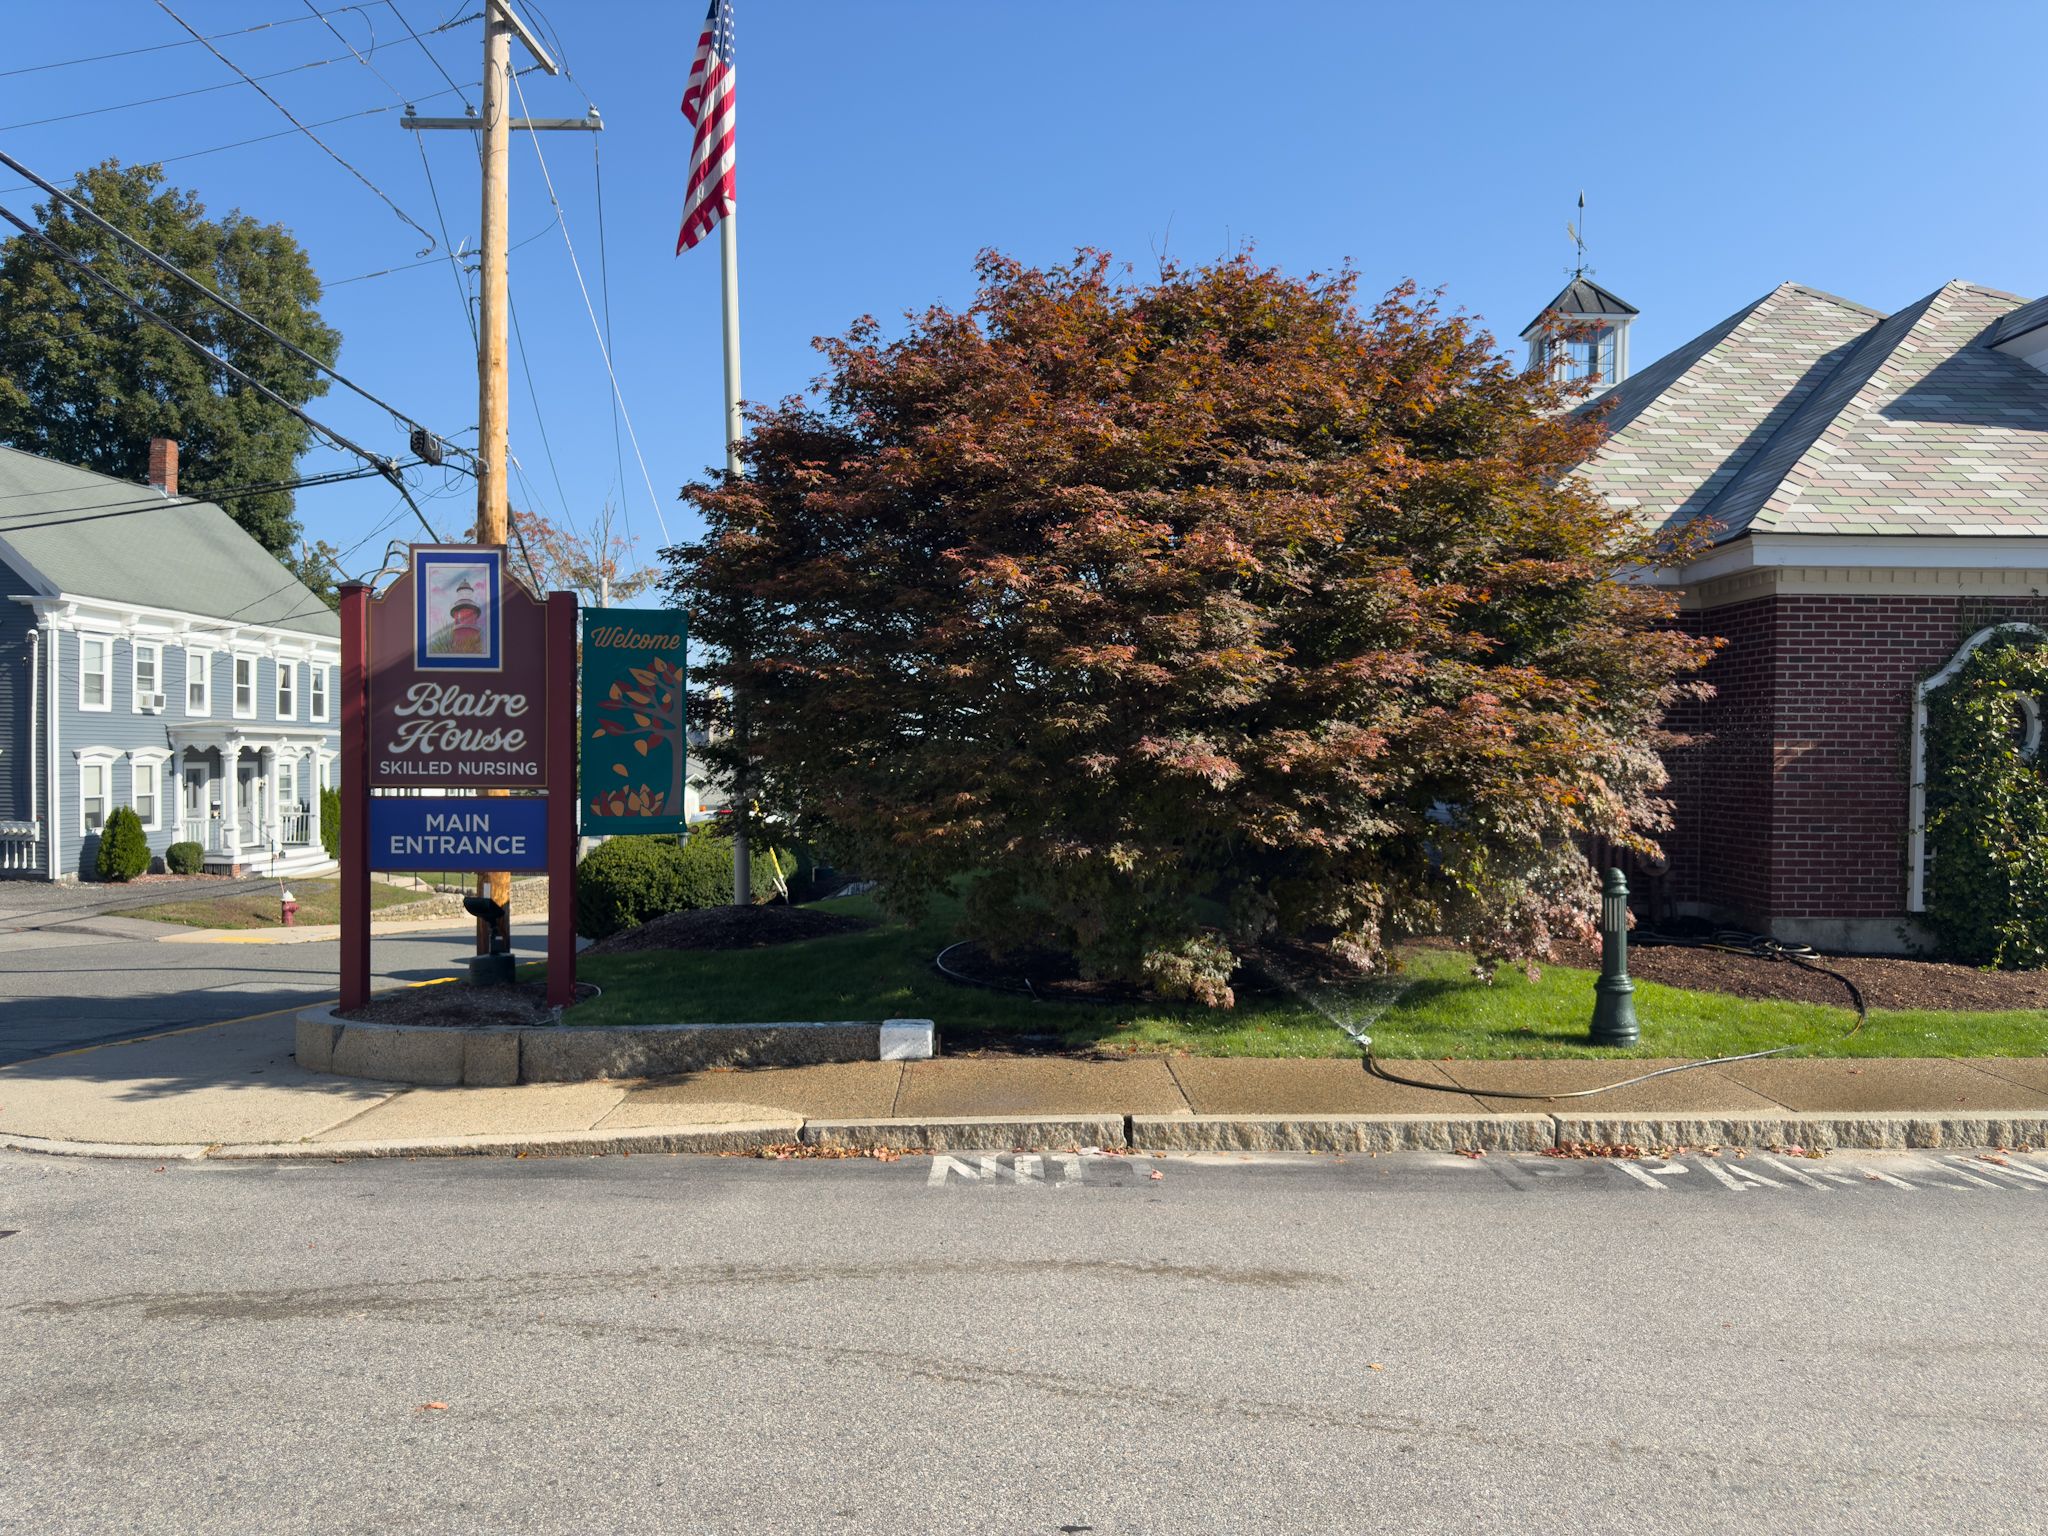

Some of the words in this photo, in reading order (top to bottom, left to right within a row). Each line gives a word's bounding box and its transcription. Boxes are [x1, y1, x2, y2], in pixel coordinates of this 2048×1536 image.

[591, 626, 681, 651] Welcome
[394, 682, 529, 718] Blaire
[388, 719, 527, 754] House
[379, 760, 452, 776] SKILLED
[457, 760, 538, 776] NURSING
[426, 813, 490, 833] MAIN
[390, 835, 526, 855] ENTRANCE
